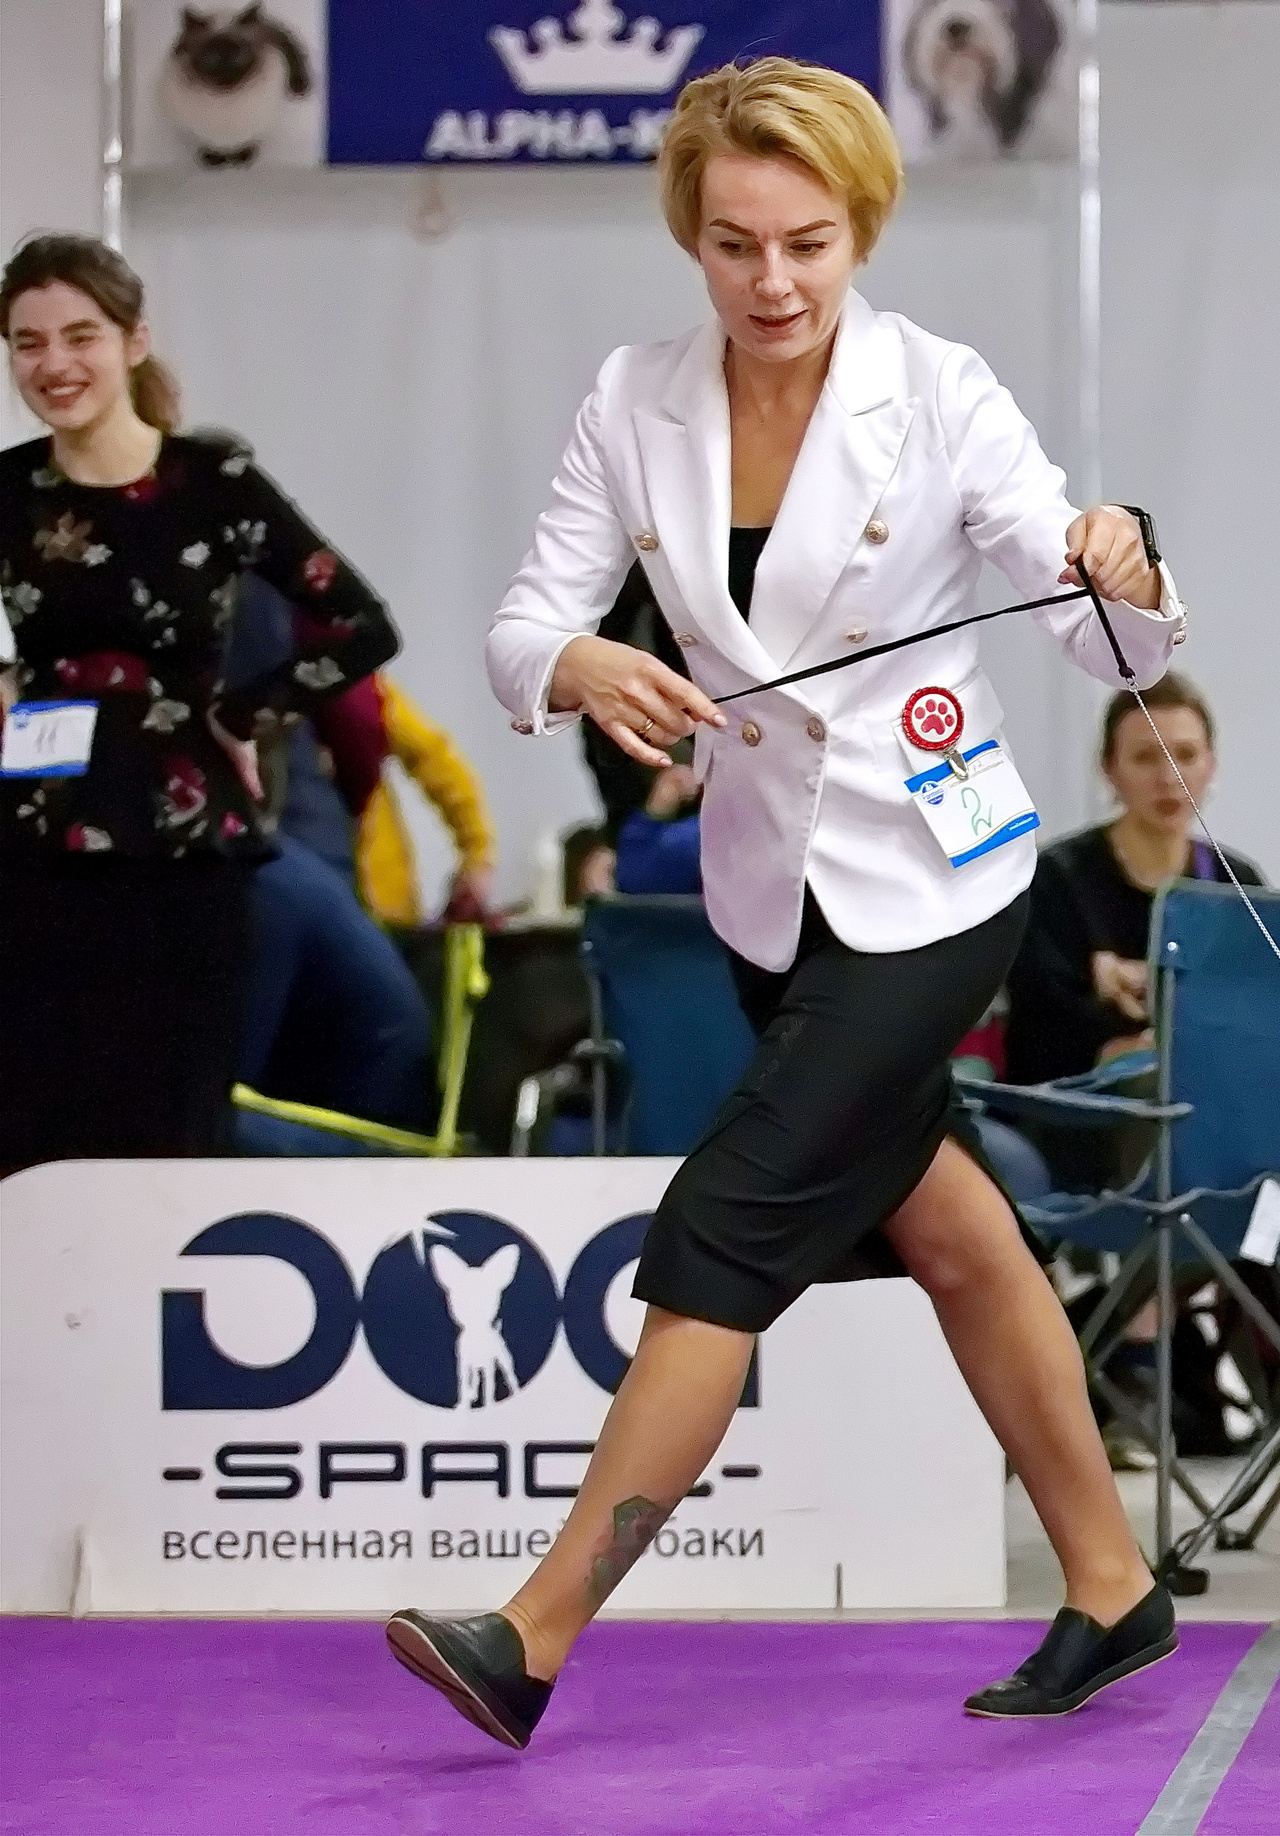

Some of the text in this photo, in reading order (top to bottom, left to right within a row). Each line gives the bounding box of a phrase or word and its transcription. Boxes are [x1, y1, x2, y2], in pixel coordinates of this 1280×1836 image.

[163, 1516, 765, 1560] вселенная ваше баки
